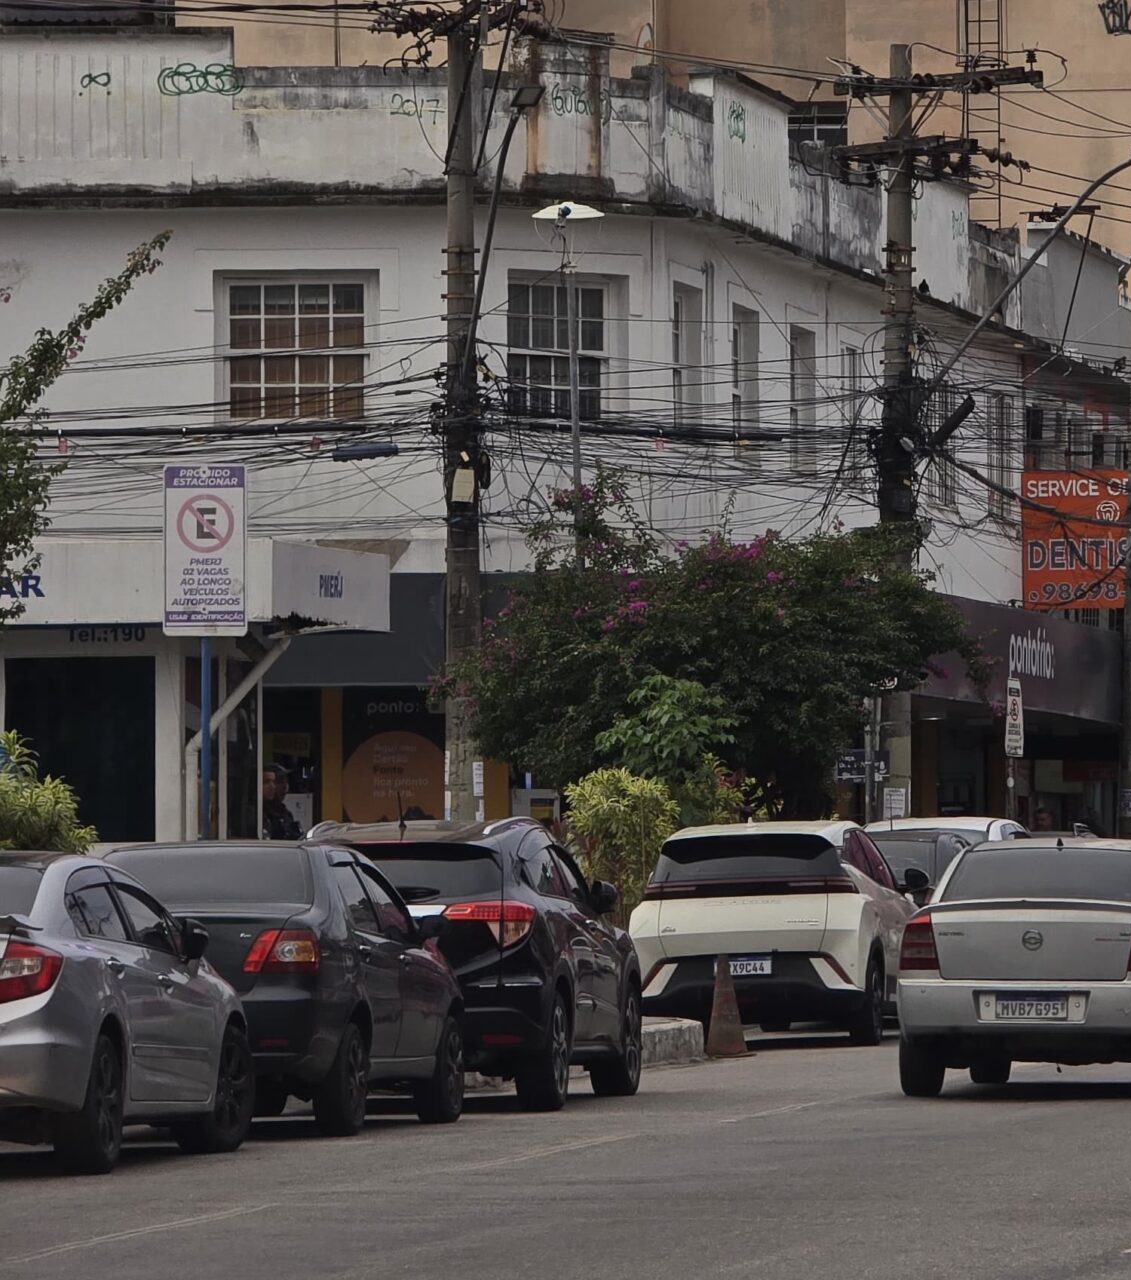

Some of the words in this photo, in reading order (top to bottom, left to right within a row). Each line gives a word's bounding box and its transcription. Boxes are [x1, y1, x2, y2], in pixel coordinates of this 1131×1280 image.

[390, 93, 446, 125] 2017
[179, 469, 231, 477] PROBIDO
[173, 477, 239, 486] ESTACIONAR
[1026, 479, 1100, 498] SERVICE
[180, 577, 195, 586] AO
[319, 574, 344, 599] PMERJ
[730, 962, 766, 975] X9C44
